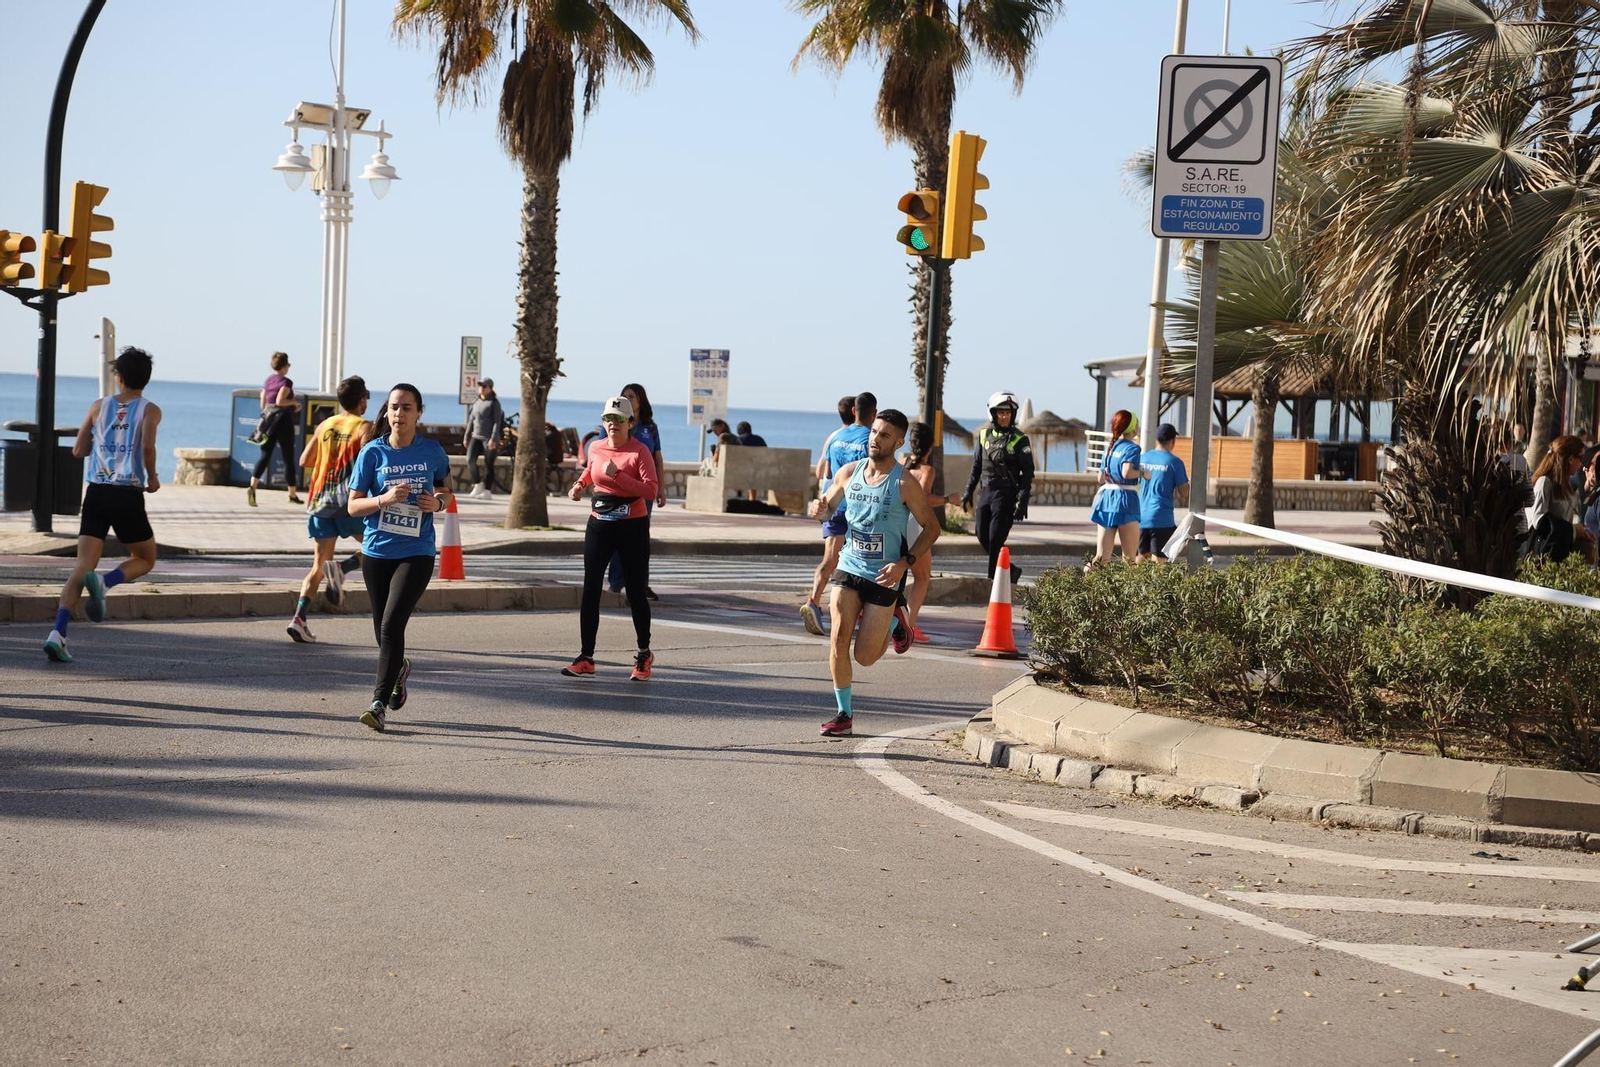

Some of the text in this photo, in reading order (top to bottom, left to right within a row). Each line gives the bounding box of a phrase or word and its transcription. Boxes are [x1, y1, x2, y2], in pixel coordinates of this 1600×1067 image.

[1181, 183, 1247, 194] SECTOR: 19
[1180, 198, 1245, 209] FIN ZONA DE
[1163, 209, 1261, 221] ESTACIONAMIENTO
[1183, 221, 1240, 232] REGULADO
[466, 376, 476, 387] 31
[111, 423, 129, 431] vive
[382, 462, 427, 474] mayoral
[849, 492, 880, 504] nerja
[386, 514, 415, 527] 1141
[854, 540, 879, 551] 1647
